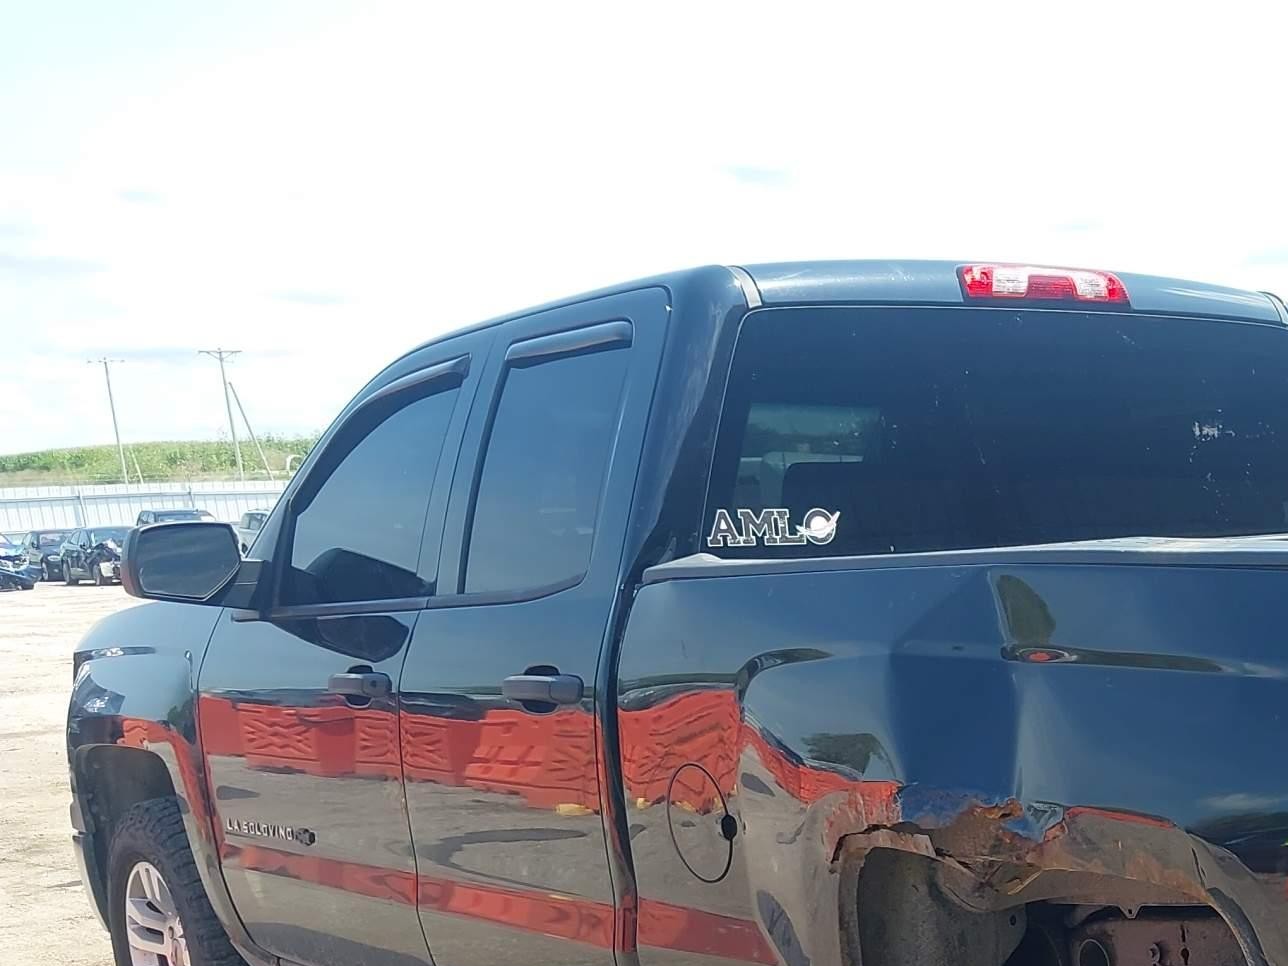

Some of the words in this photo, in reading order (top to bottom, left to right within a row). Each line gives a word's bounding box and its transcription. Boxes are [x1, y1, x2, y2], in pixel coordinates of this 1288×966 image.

[706, 507, 841, 547] AMLO
[226, 817, 241, 832] LA
[242, 821, 295, 841] SOLOVINO
